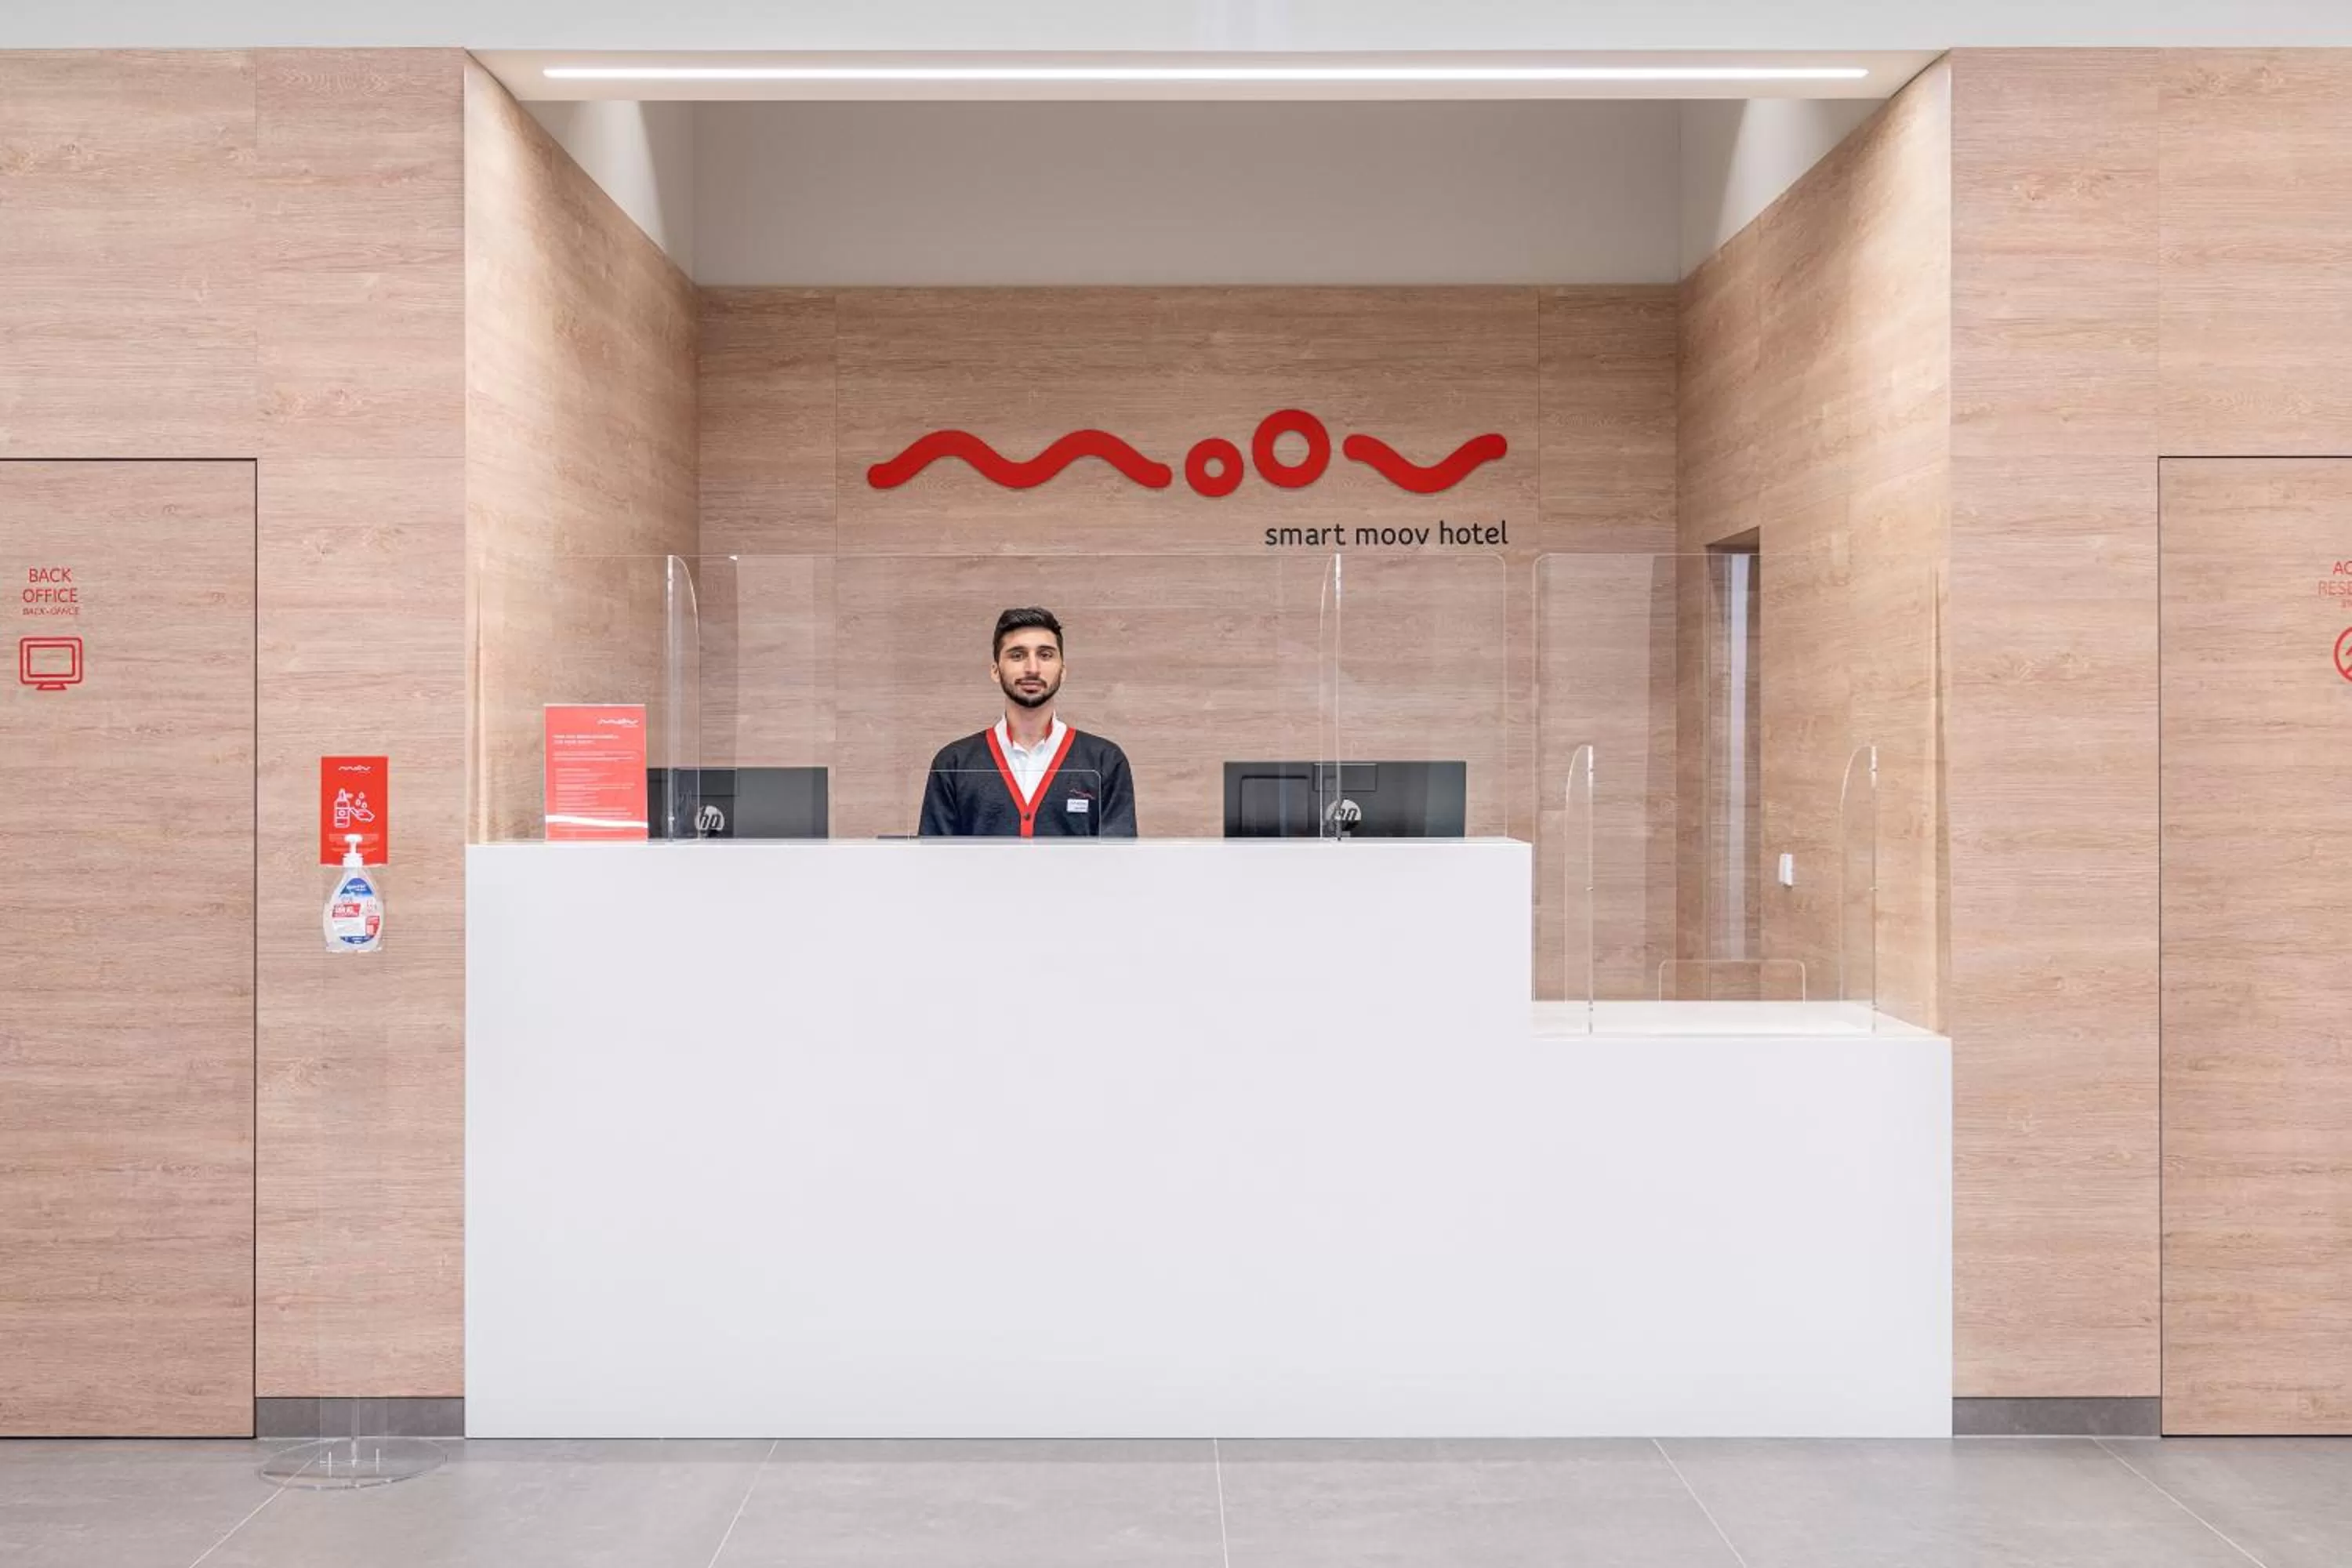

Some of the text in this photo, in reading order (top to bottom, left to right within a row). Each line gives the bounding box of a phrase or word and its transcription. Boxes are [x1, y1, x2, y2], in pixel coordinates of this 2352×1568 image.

[1265, 520, 1508, 546] smart moov hotel
[29, 568, 71, 583] BACK
[22, 587, 78, 603] OFFICE
[697, 805, 723, 833] hp
